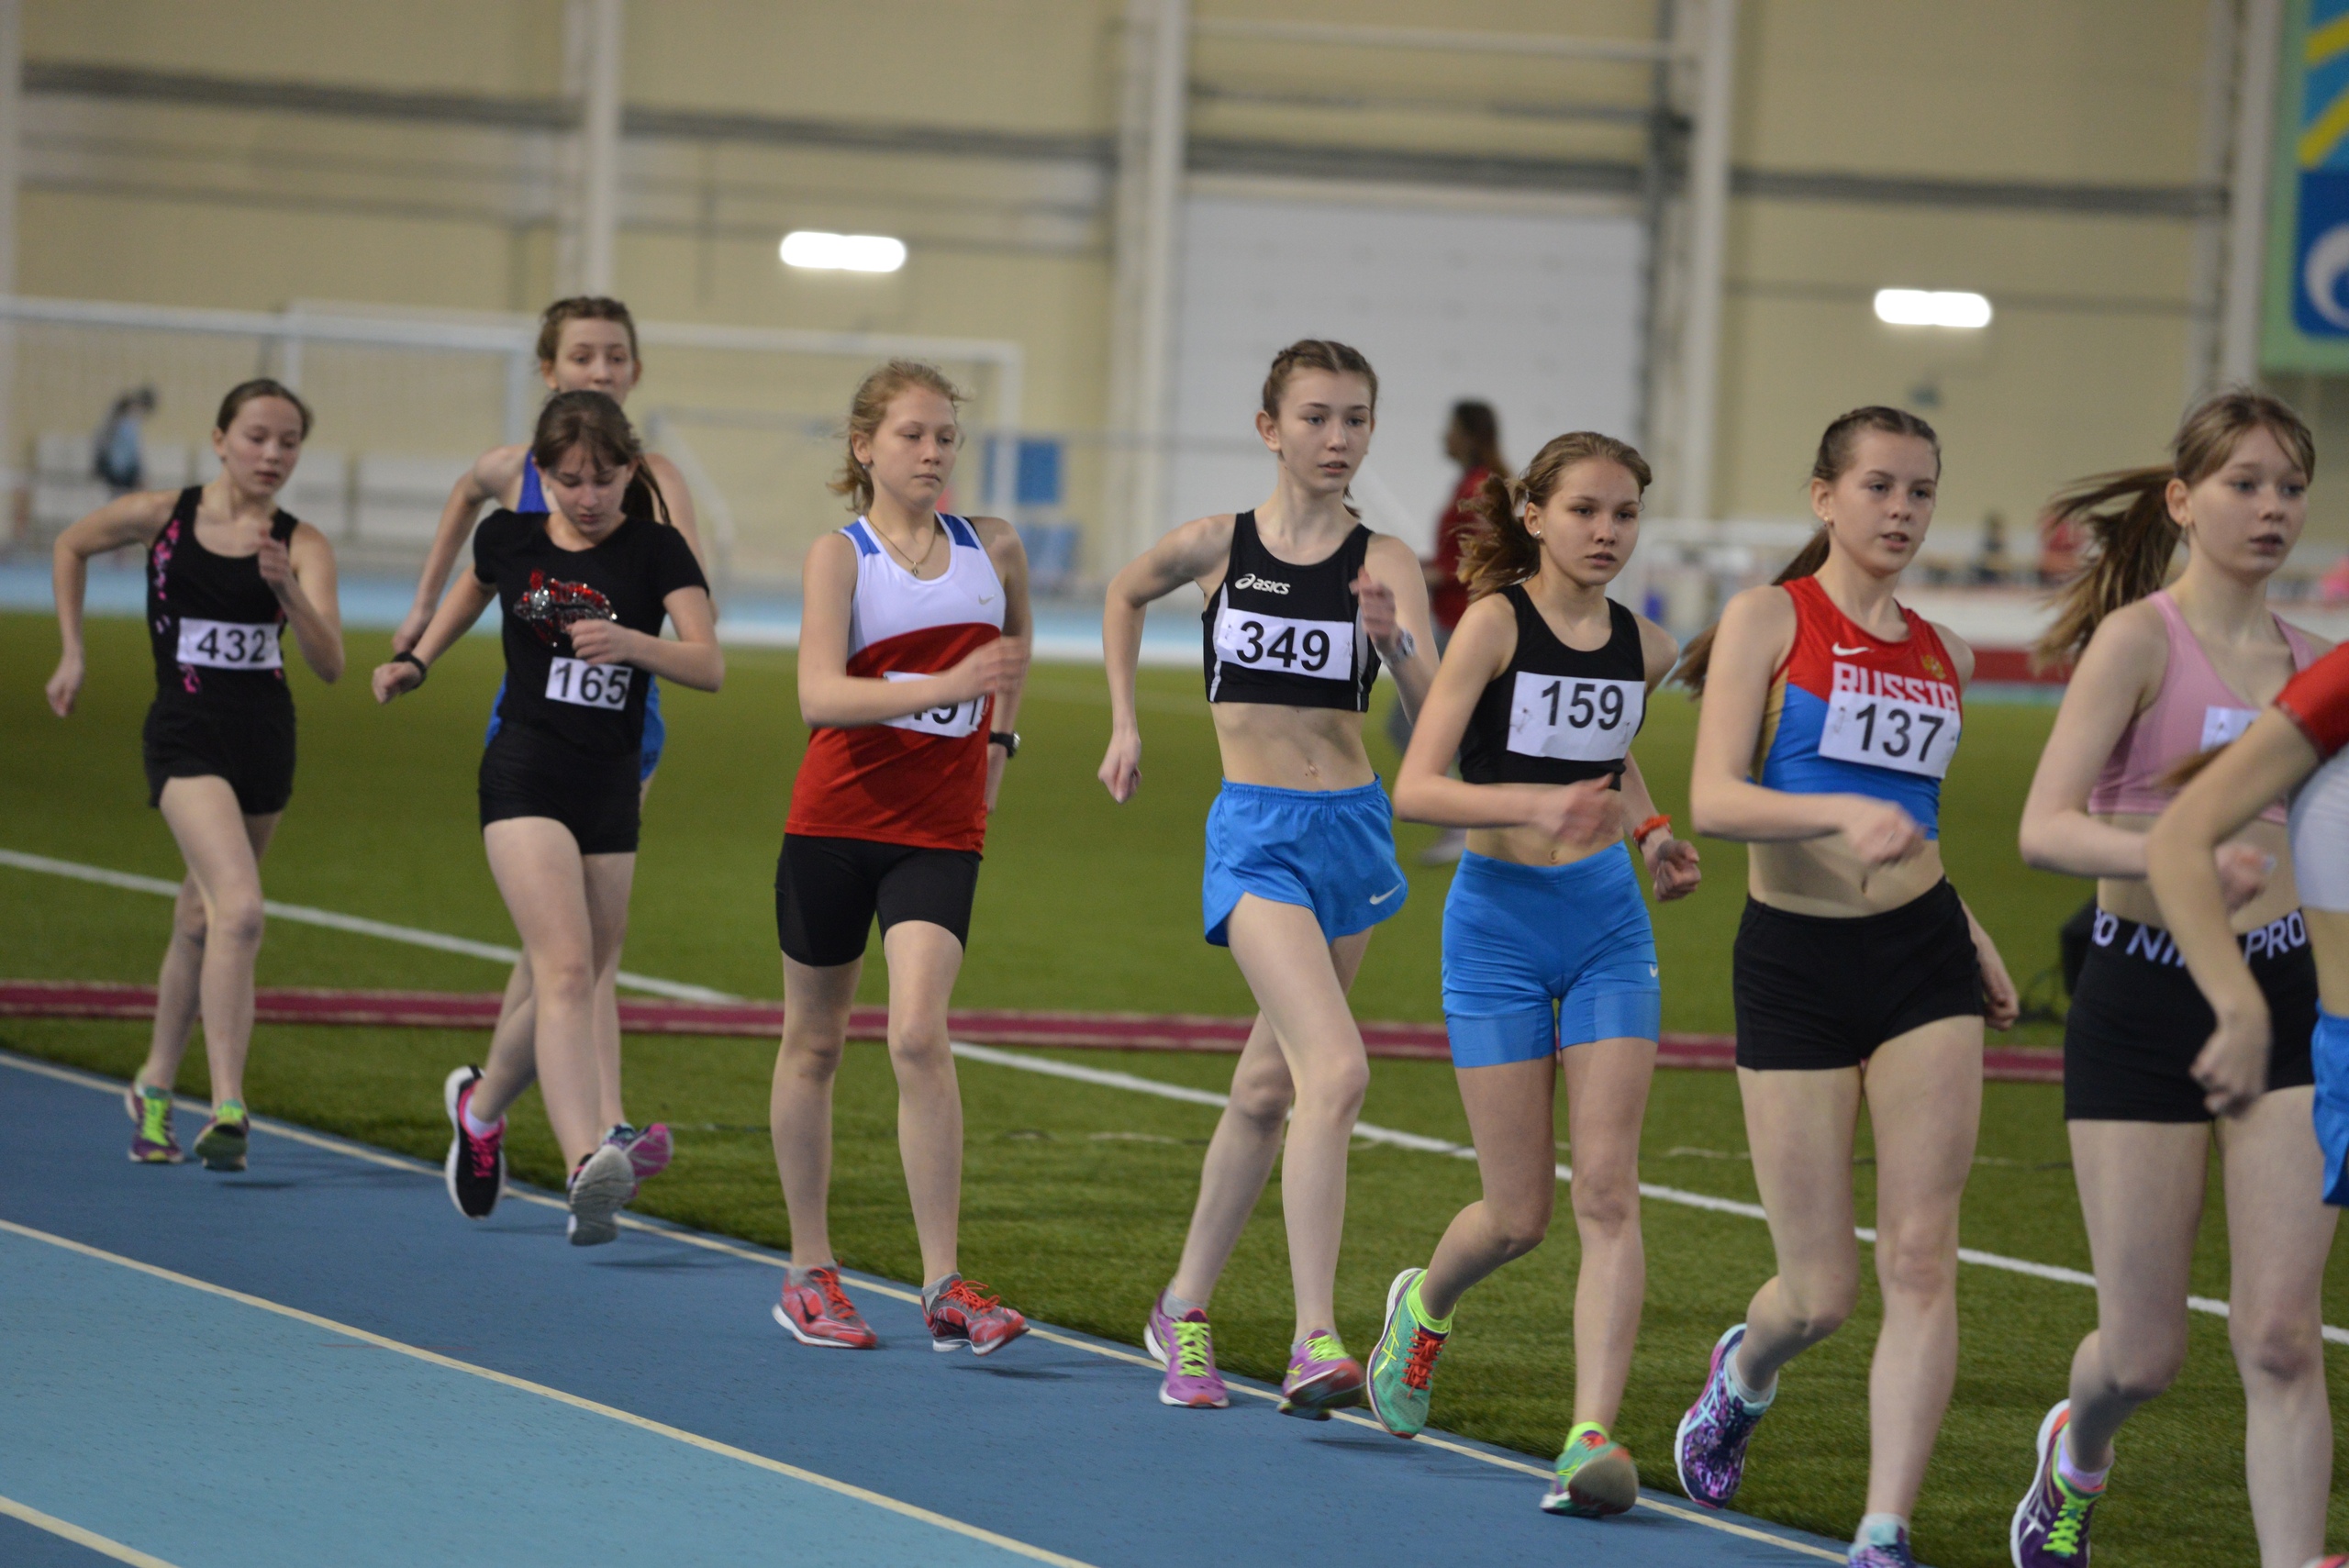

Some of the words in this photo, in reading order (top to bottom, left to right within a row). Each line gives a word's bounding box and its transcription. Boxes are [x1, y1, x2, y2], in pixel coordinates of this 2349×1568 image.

[1252, 577, 1291, 595] asics
[197, 628, 266, 663] 432
[1236, 620, 1330, 672] 349
[555, 662, 629, 705] 165
[1541, 680, 1624, 730] 159
[1833, 661, 1957, 712] RUSSIA
[1855, 703, 1945, 762] 137
[2243, 909, 2307, 965] PRO
